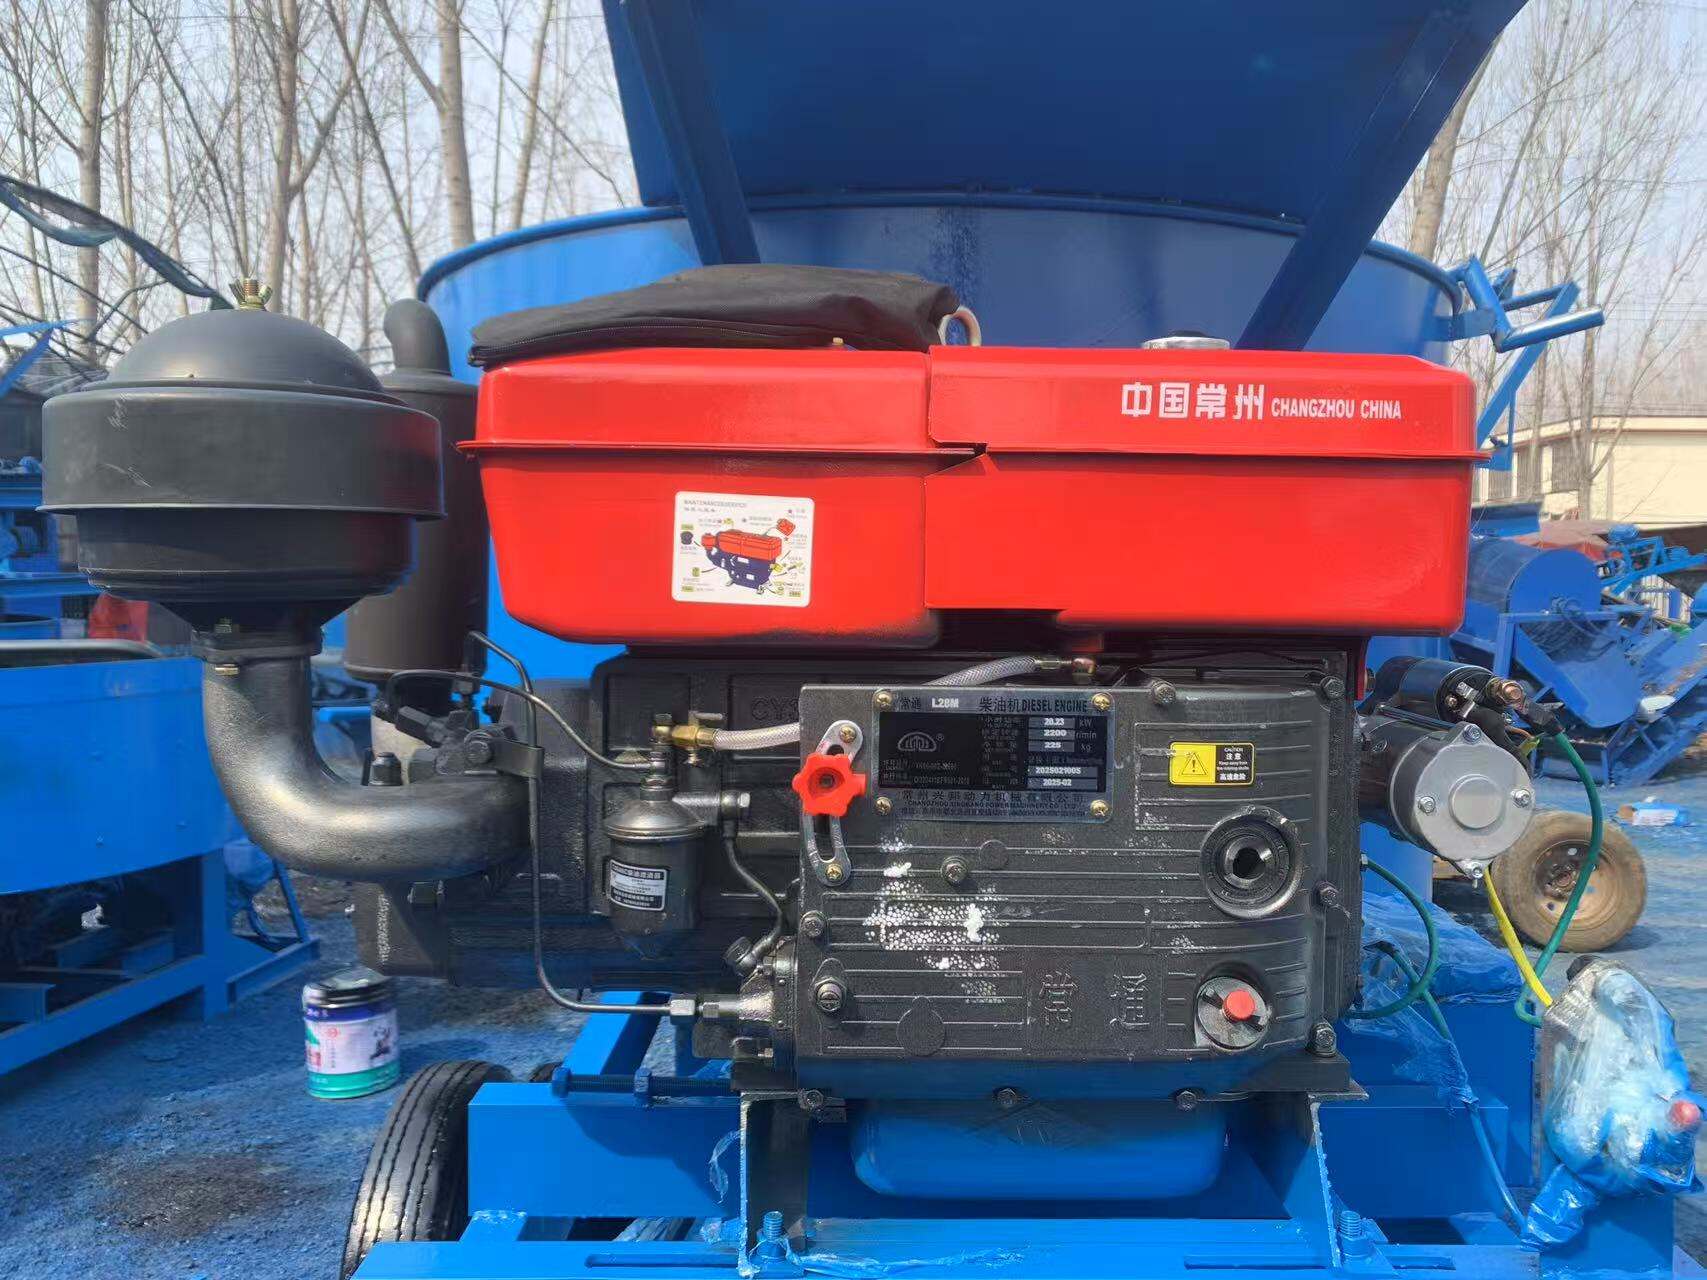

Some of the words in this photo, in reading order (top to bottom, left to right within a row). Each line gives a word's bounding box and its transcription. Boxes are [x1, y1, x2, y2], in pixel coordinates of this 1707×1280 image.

[1121, 381, 1265, 420] 中国常州
[1271, 397, 1355, 418] CHANGZHOU
[1360, 399, 1402, 420] CHINA
[931, 697, 959, 709] L28M
[979, 696, 1020, 713] 柴油机
[1022, 698, 1052, 712] DIESEL
[1054, 699, 1088, 713] ENGINE
[1226, 752, 1242, 760] 注意
